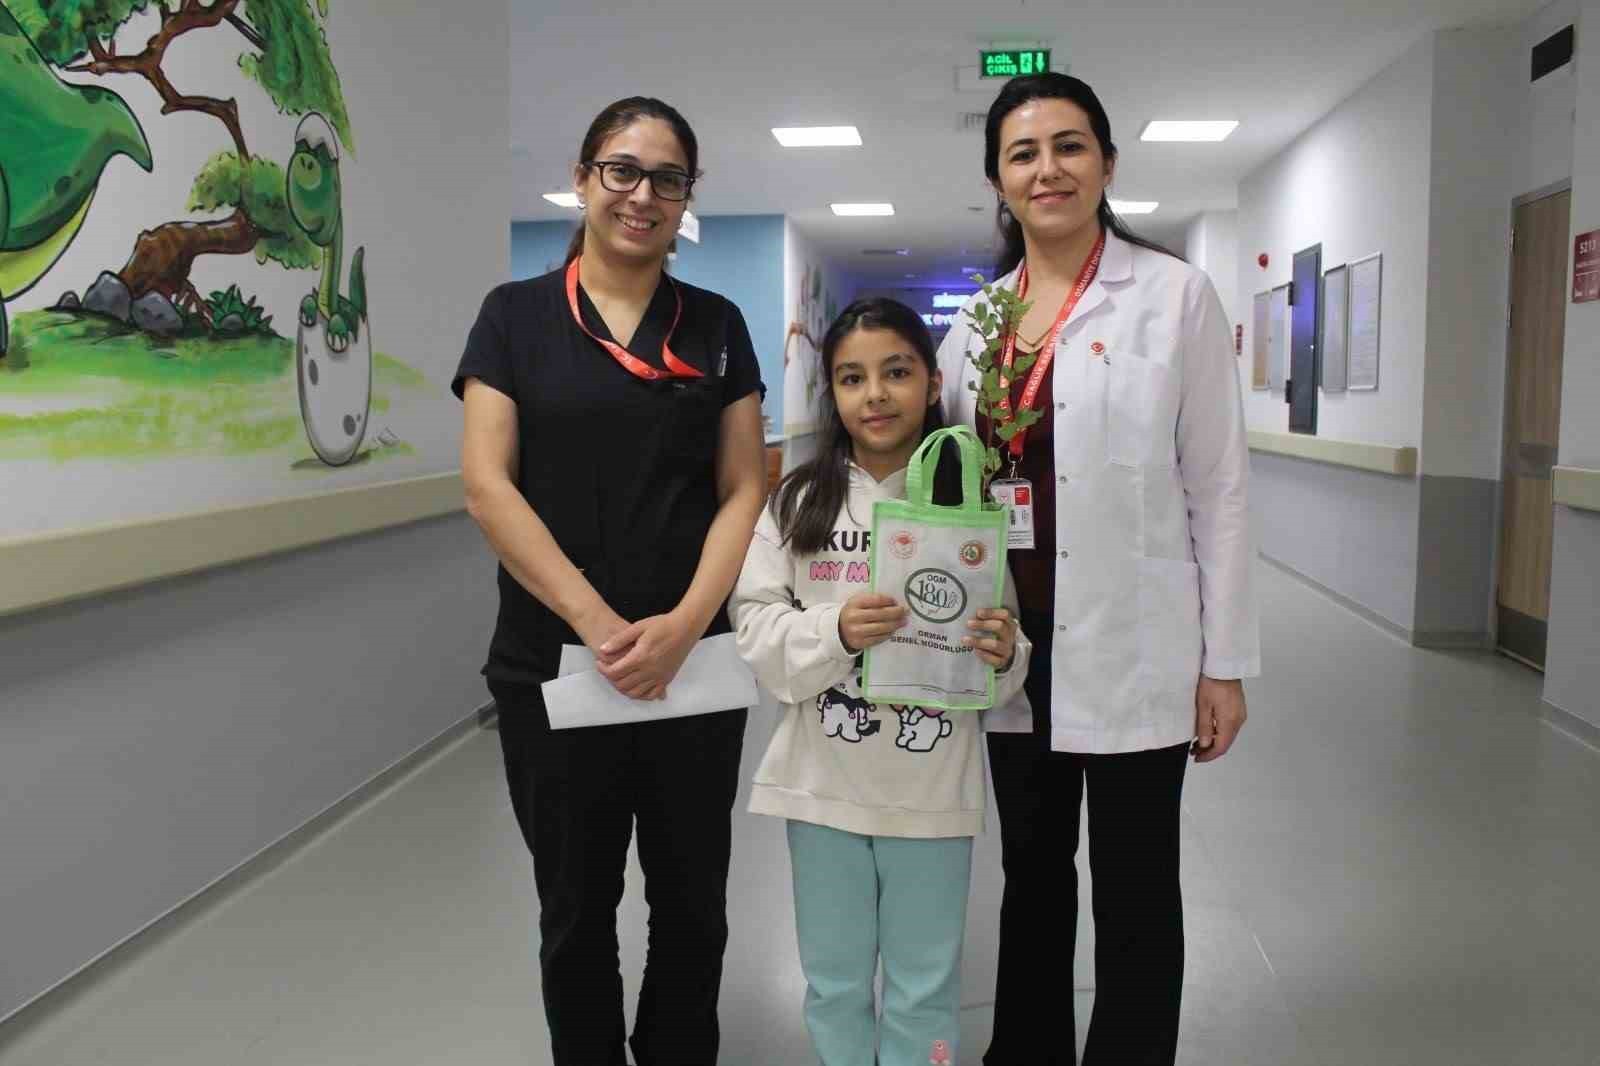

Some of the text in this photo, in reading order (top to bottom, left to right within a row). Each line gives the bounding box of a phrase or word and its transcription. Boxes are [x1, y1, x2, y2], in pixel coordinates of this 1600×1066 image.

[986, 54, 1013, 64] ACİL
[986, 64, 1017, 75] ÇIKIŞ
[810, 561, 844, 581] MY
[927, 574, 947, 584] OGM
[890, 635, 919, 646] GENEL
[917, 630, 948, 642] ORMAN
